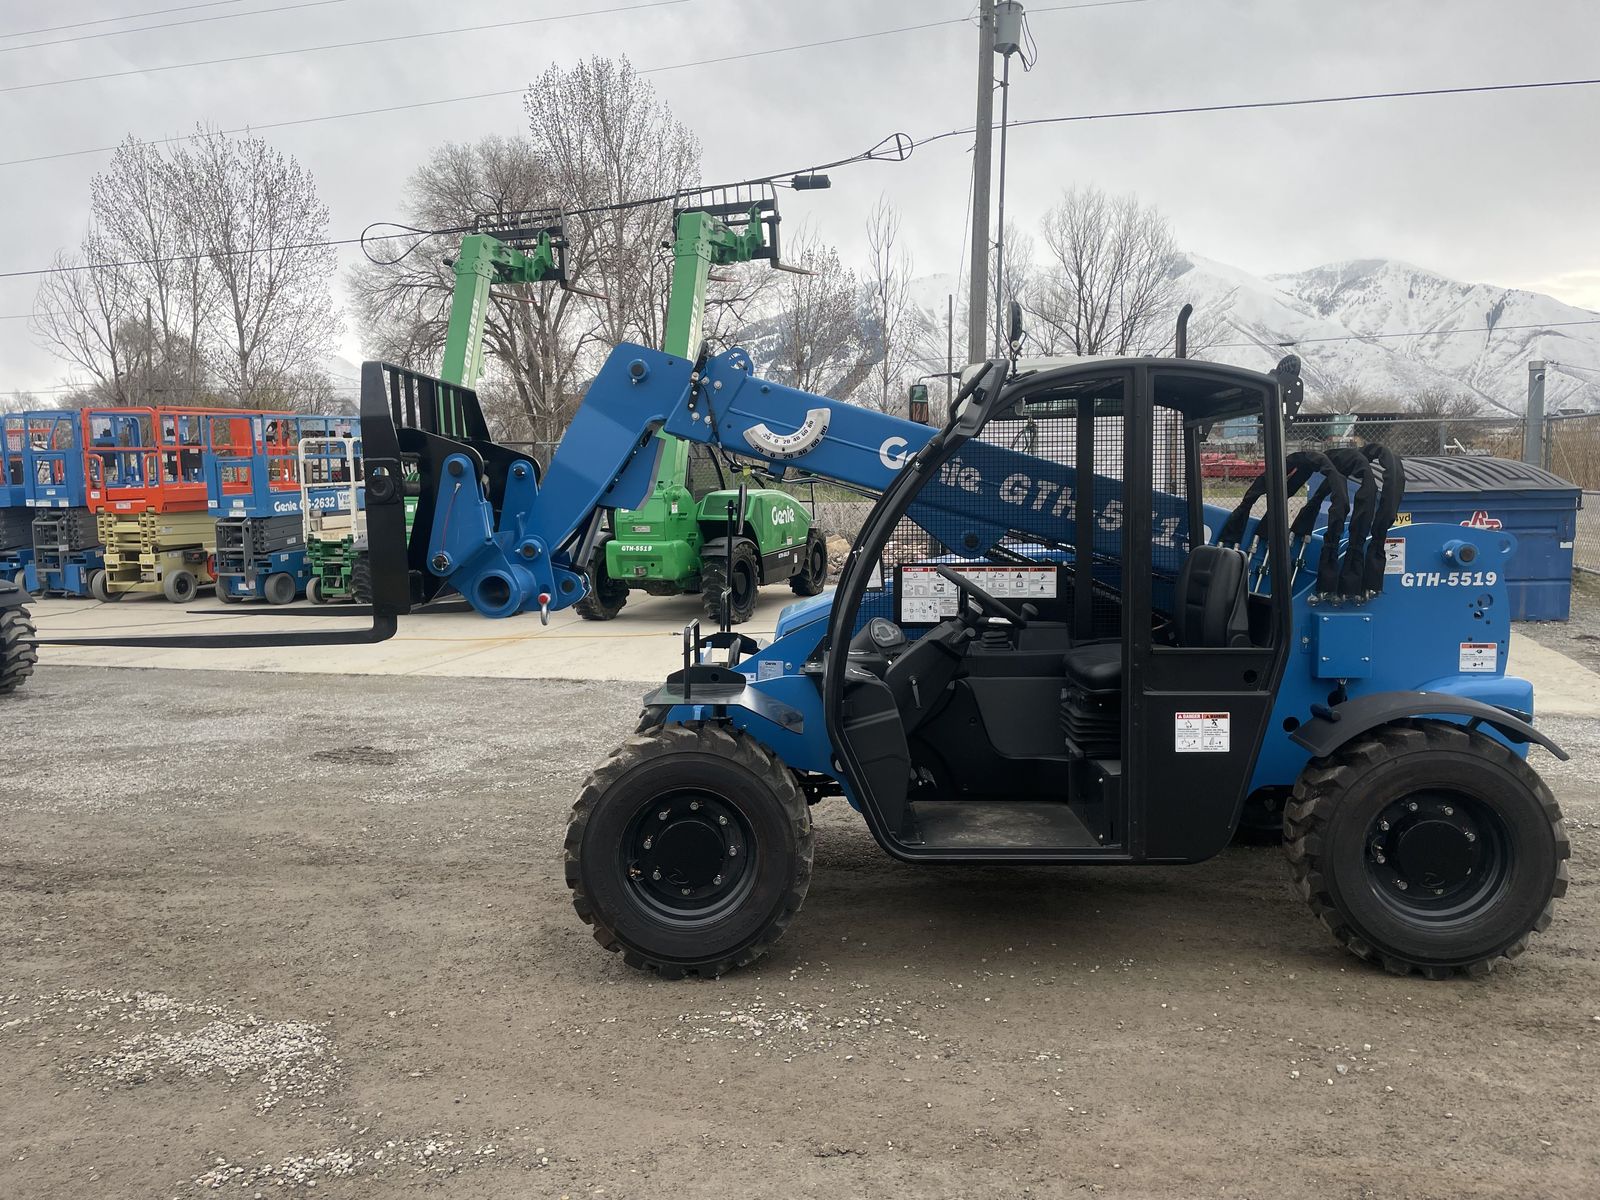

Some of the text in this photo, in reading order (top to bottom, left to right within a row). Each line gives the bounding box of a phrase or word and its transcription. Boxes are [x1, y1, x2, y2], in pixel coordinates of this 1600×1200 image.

[798, 448, 808, 456] 40
[811, 438, 820, 448] 60
[820, 425, 828, 436] 80
[879, 436, 1212, 554] Gie GTH51
[274, 500, 298, 512] Genie
[772, 505, 796, 526] Genie
[1401, 571, 1497, 587] GTH-5519
